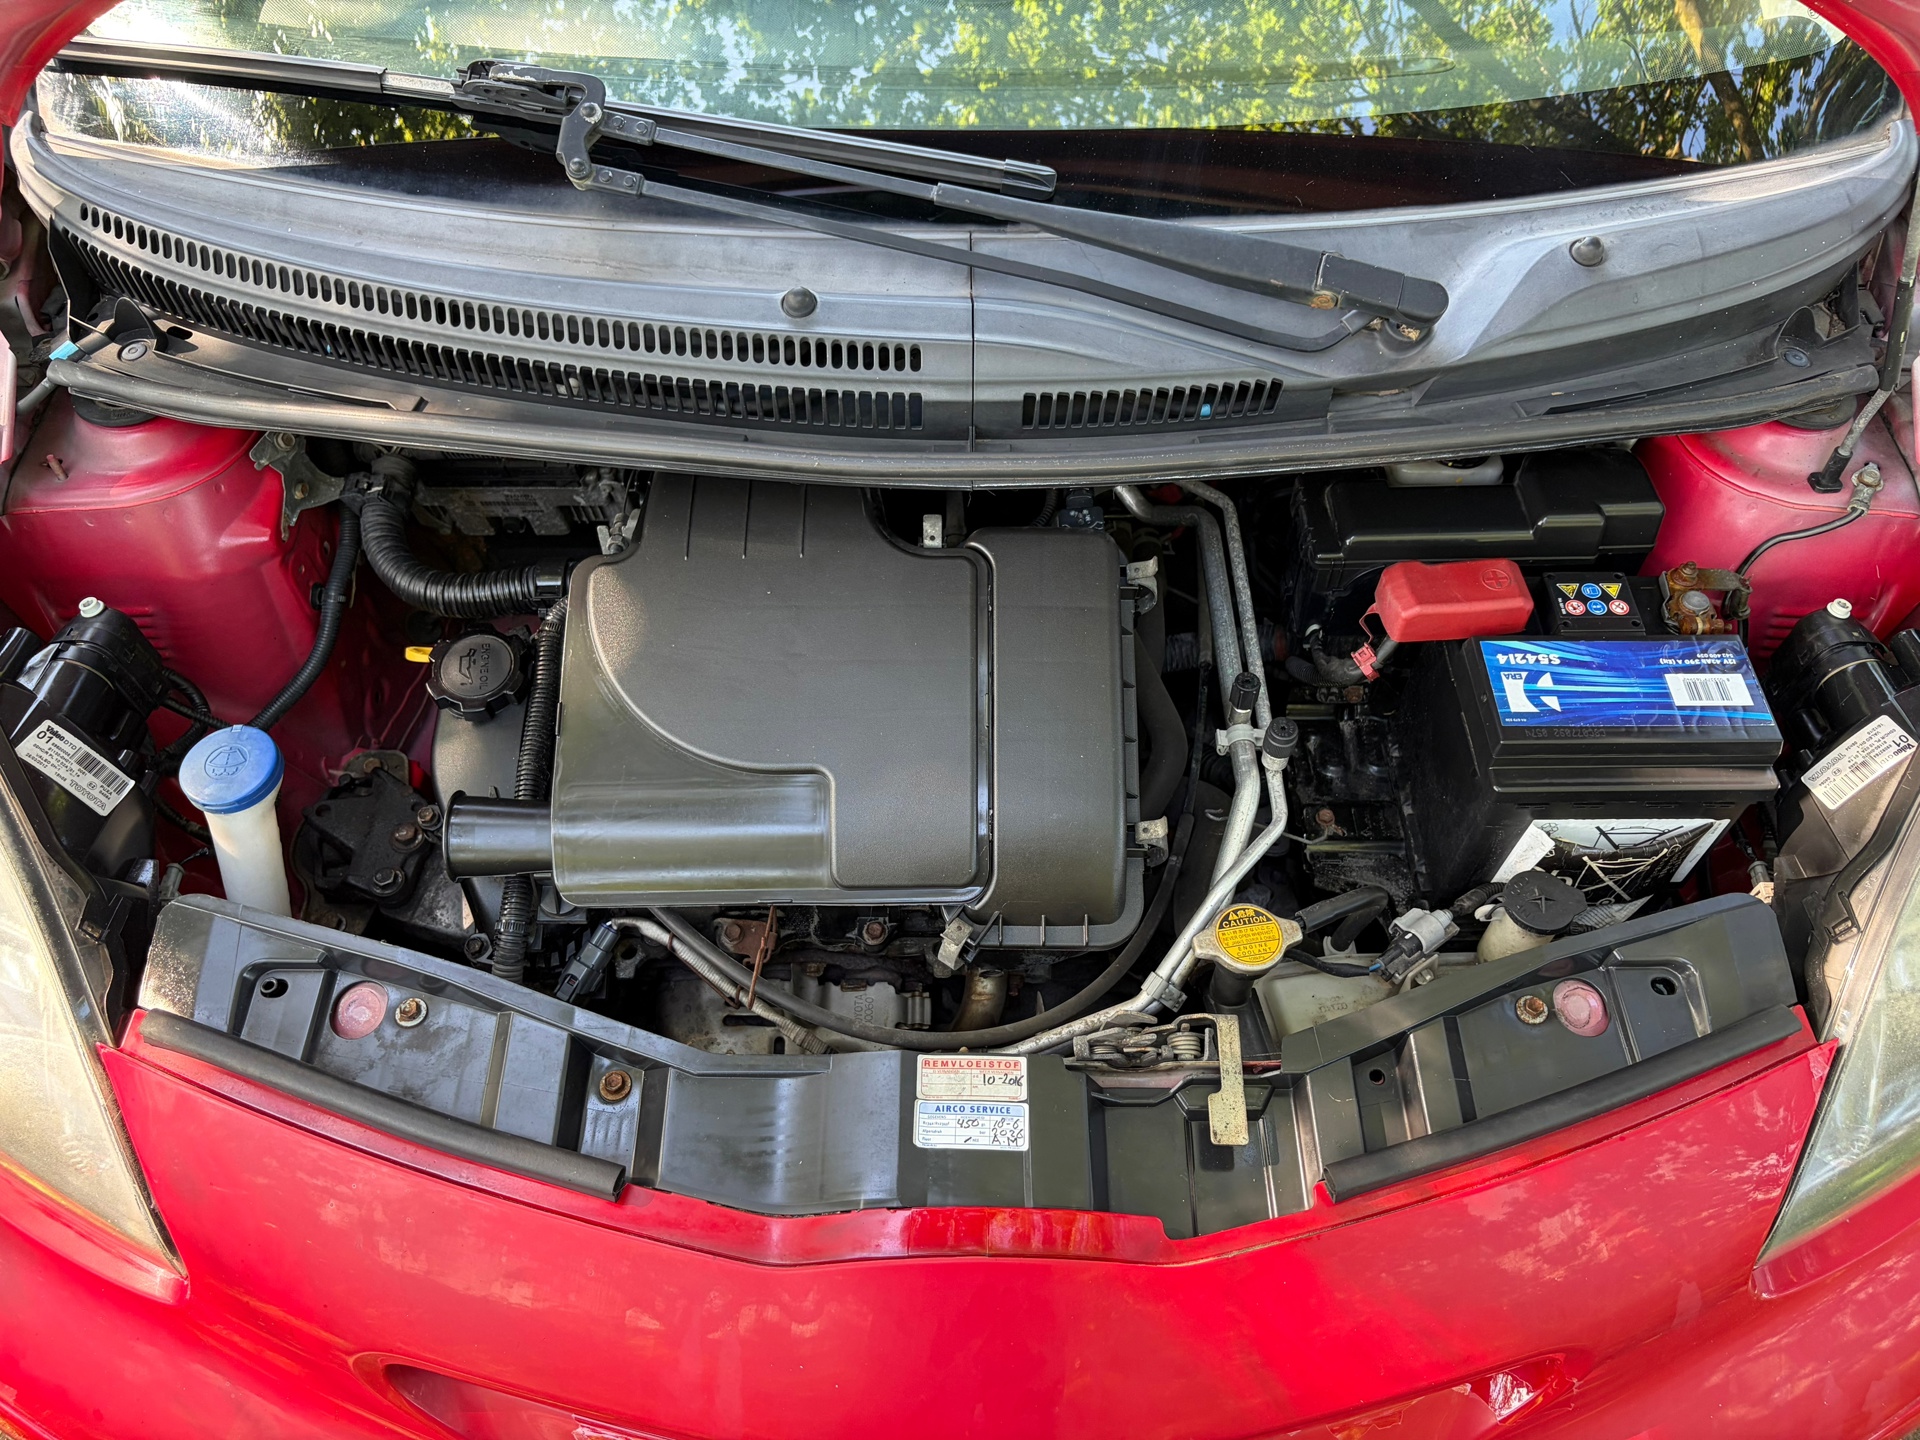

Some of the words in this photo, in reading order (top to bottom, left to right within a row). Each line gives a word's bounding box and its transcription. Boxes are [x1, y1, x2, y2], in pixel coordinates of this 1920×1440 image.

[480, 644, 490, 673] ENGINE
[1497, 653, 1560, 665] S54214
[1502, 672, 1523, 680] ERA
[479, 676, 488, 689] OIL
[37, 731, 53, 743] 01
[47, 726, 64, 741] Valeo
[1866, 731, 1880, 742] VALEO
[1892, 735, 1909, 747] 01
[1893, 743, 1914, 756] Valeo
[36, 754, 51, 764] VALEO
[1806, 753, 1845, 782] TOYOTA
[70, 780, 106, 810] TOYOTA
[1223, 916, 1266, 928] CAUTION
[1237, 947, 1271, 957] COOLANT
[1238, 942, 1267, 951] ENGINE
[924, 1060, 1020, 1068] REMVLOEISTOF
[970, 1106, 1011, 1114] SERVICE
[957, 1119, 979, 1129] 450
